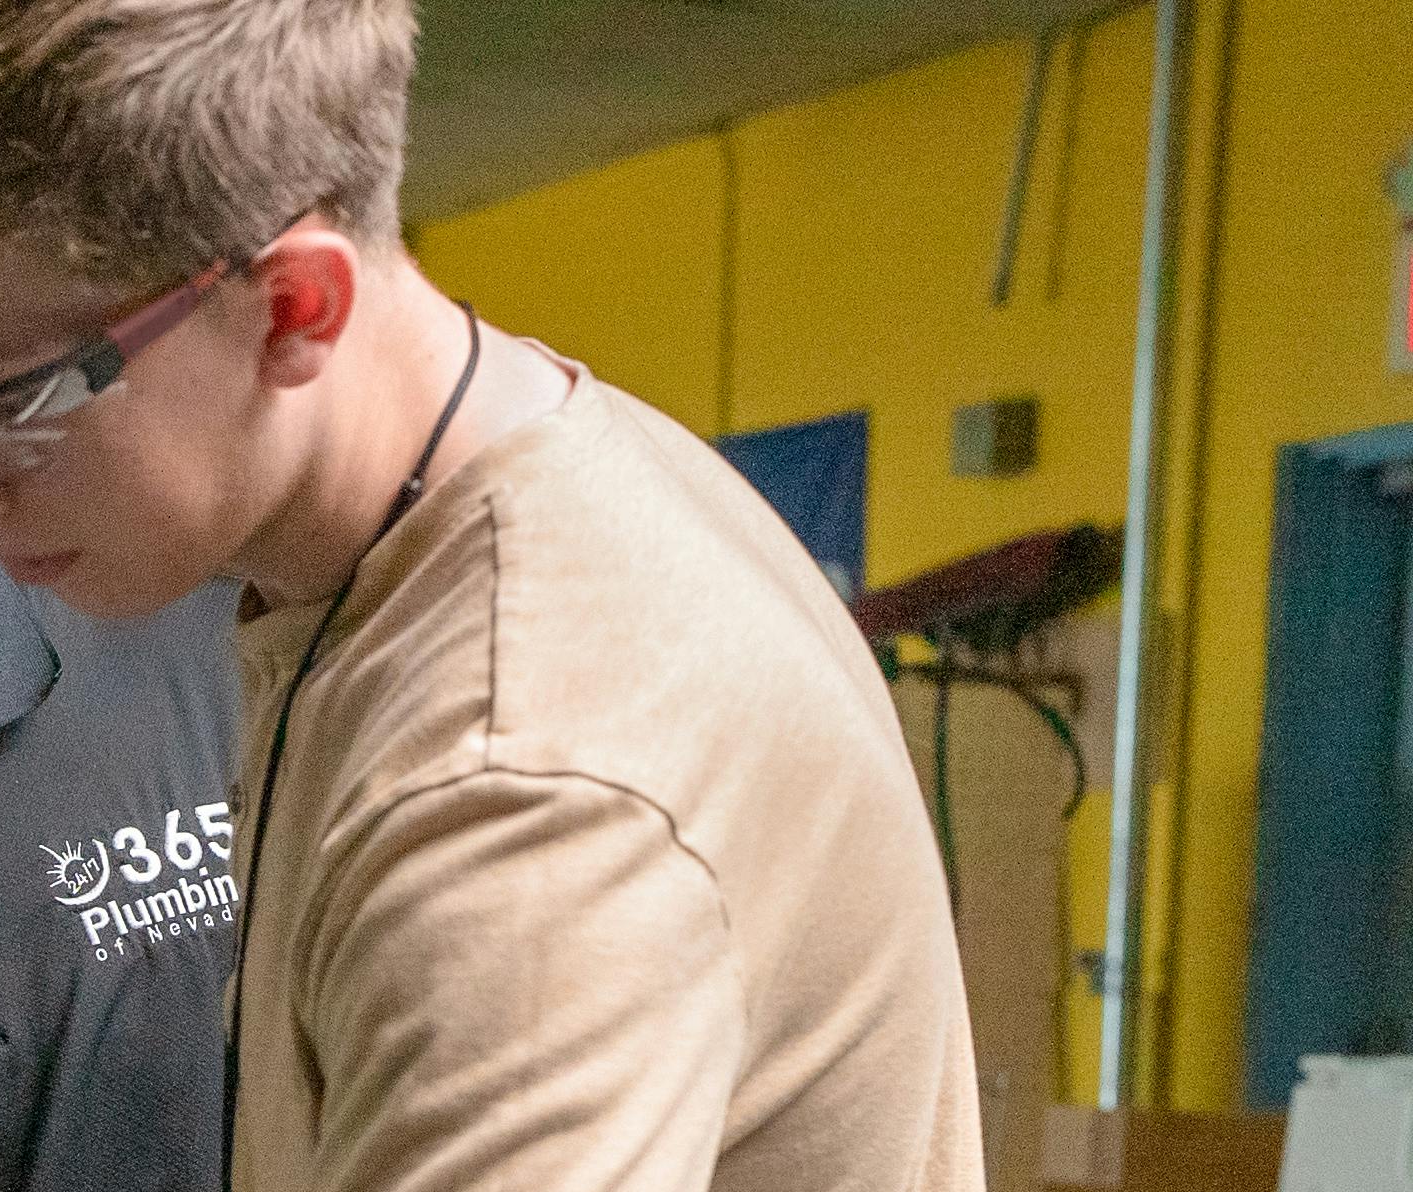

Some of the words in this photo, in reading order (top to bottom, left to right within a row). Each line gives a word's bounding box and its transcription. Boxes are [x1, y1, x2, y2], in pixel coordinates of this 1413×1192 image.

[67, 857, 102, 895] 24/7
[112, 801, 235, 885] 365
[79, 866, 240, 946] Plumbin
[95, 936, 125, 962] of
[147, 904, 235, 944] Nevad
